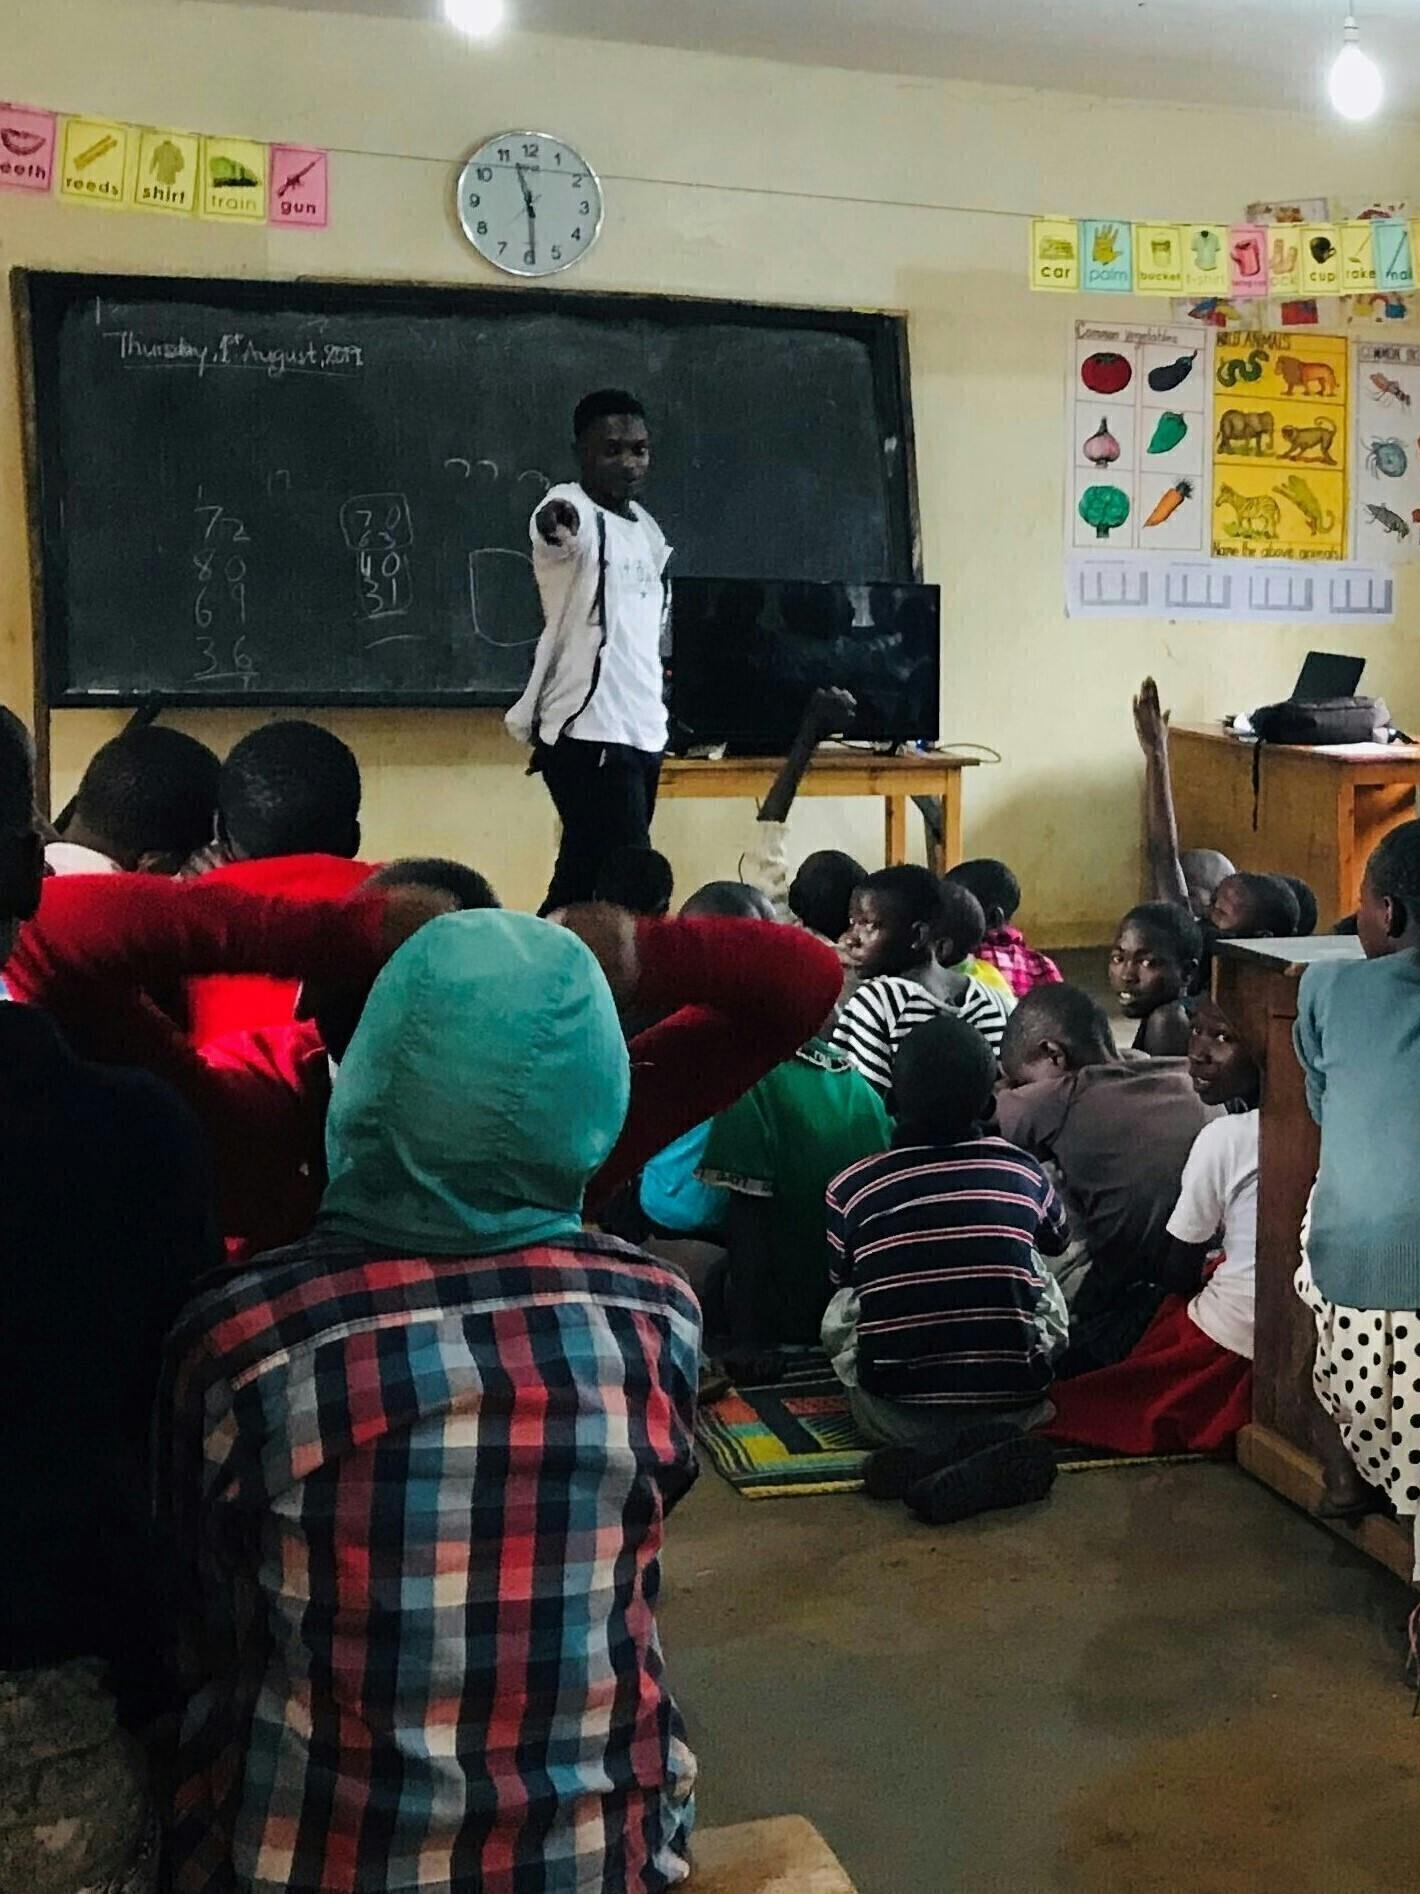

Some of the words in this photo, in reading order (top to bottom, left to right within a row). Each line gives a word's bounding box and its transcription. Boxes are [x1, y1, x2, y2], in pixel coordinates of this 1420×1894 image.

[497, 148, 510, 162] 11
[522, 144, 539, 158] 12
[554, 152, 561, 165] 1
[476, 167, 493, 182] 10
[572, 174, 582, 188] 2
[66, 177, 119, 196] reeds
[143, 185, 185, 205] shirt
[211, 194, 256, 211] train
[469, 193, 480, 208] 9
[280, 200, 316, 216] gun
[579, 200, 589, 215] 3
[477, 220, 488, 235] 8
[571, 227, 580, 241] 4
[497, 241, 507, 255] 7
[551, 244, 561, 260] 5
[1040, 265, 1071, 280] car
[1088, 264, 1129, 283] palm
[1139, 271, 1180, 282] bucket
[1309, 271, 1336, 282] cup
[1345, 267, 1377, 280] rake
